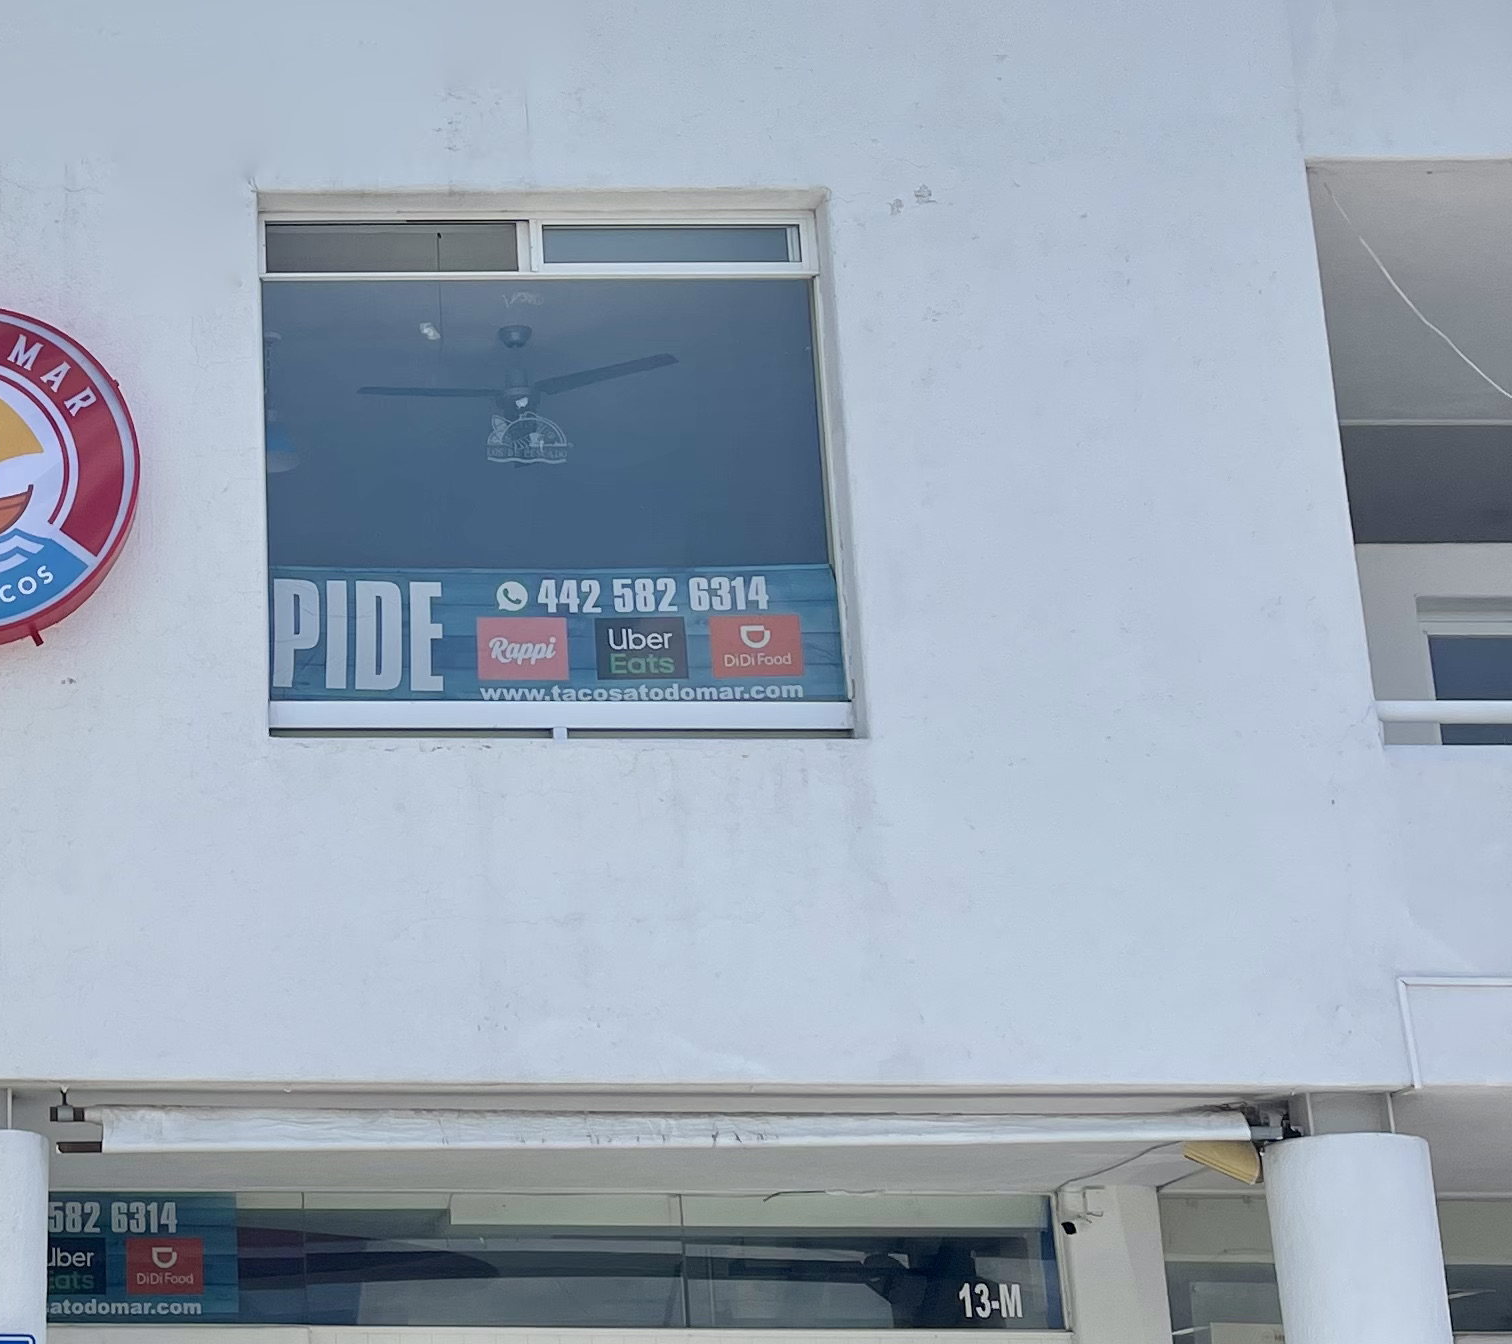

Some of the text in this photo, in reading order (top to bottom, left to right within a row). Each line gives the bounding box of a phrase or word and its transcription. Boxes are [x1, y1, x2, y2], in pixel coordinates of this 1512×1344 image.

[7, 334, 97, 416] MAR
[537, 575, 769, 613] 442 582 6314
[273, 578, 444, 691] PIDE
[608, 628, 673, 650] Uber
[488, 636, 556, 666] Rappi
[610, 653, 675, 675] Eats
[480, 683, 804, 701] www.tacosatodomar.com
[111, 1201, 178, 1234] 6314
[47, 1299, 202, 1315] atodomar.com
[958, 1283, 1024, 1320] 13-M
